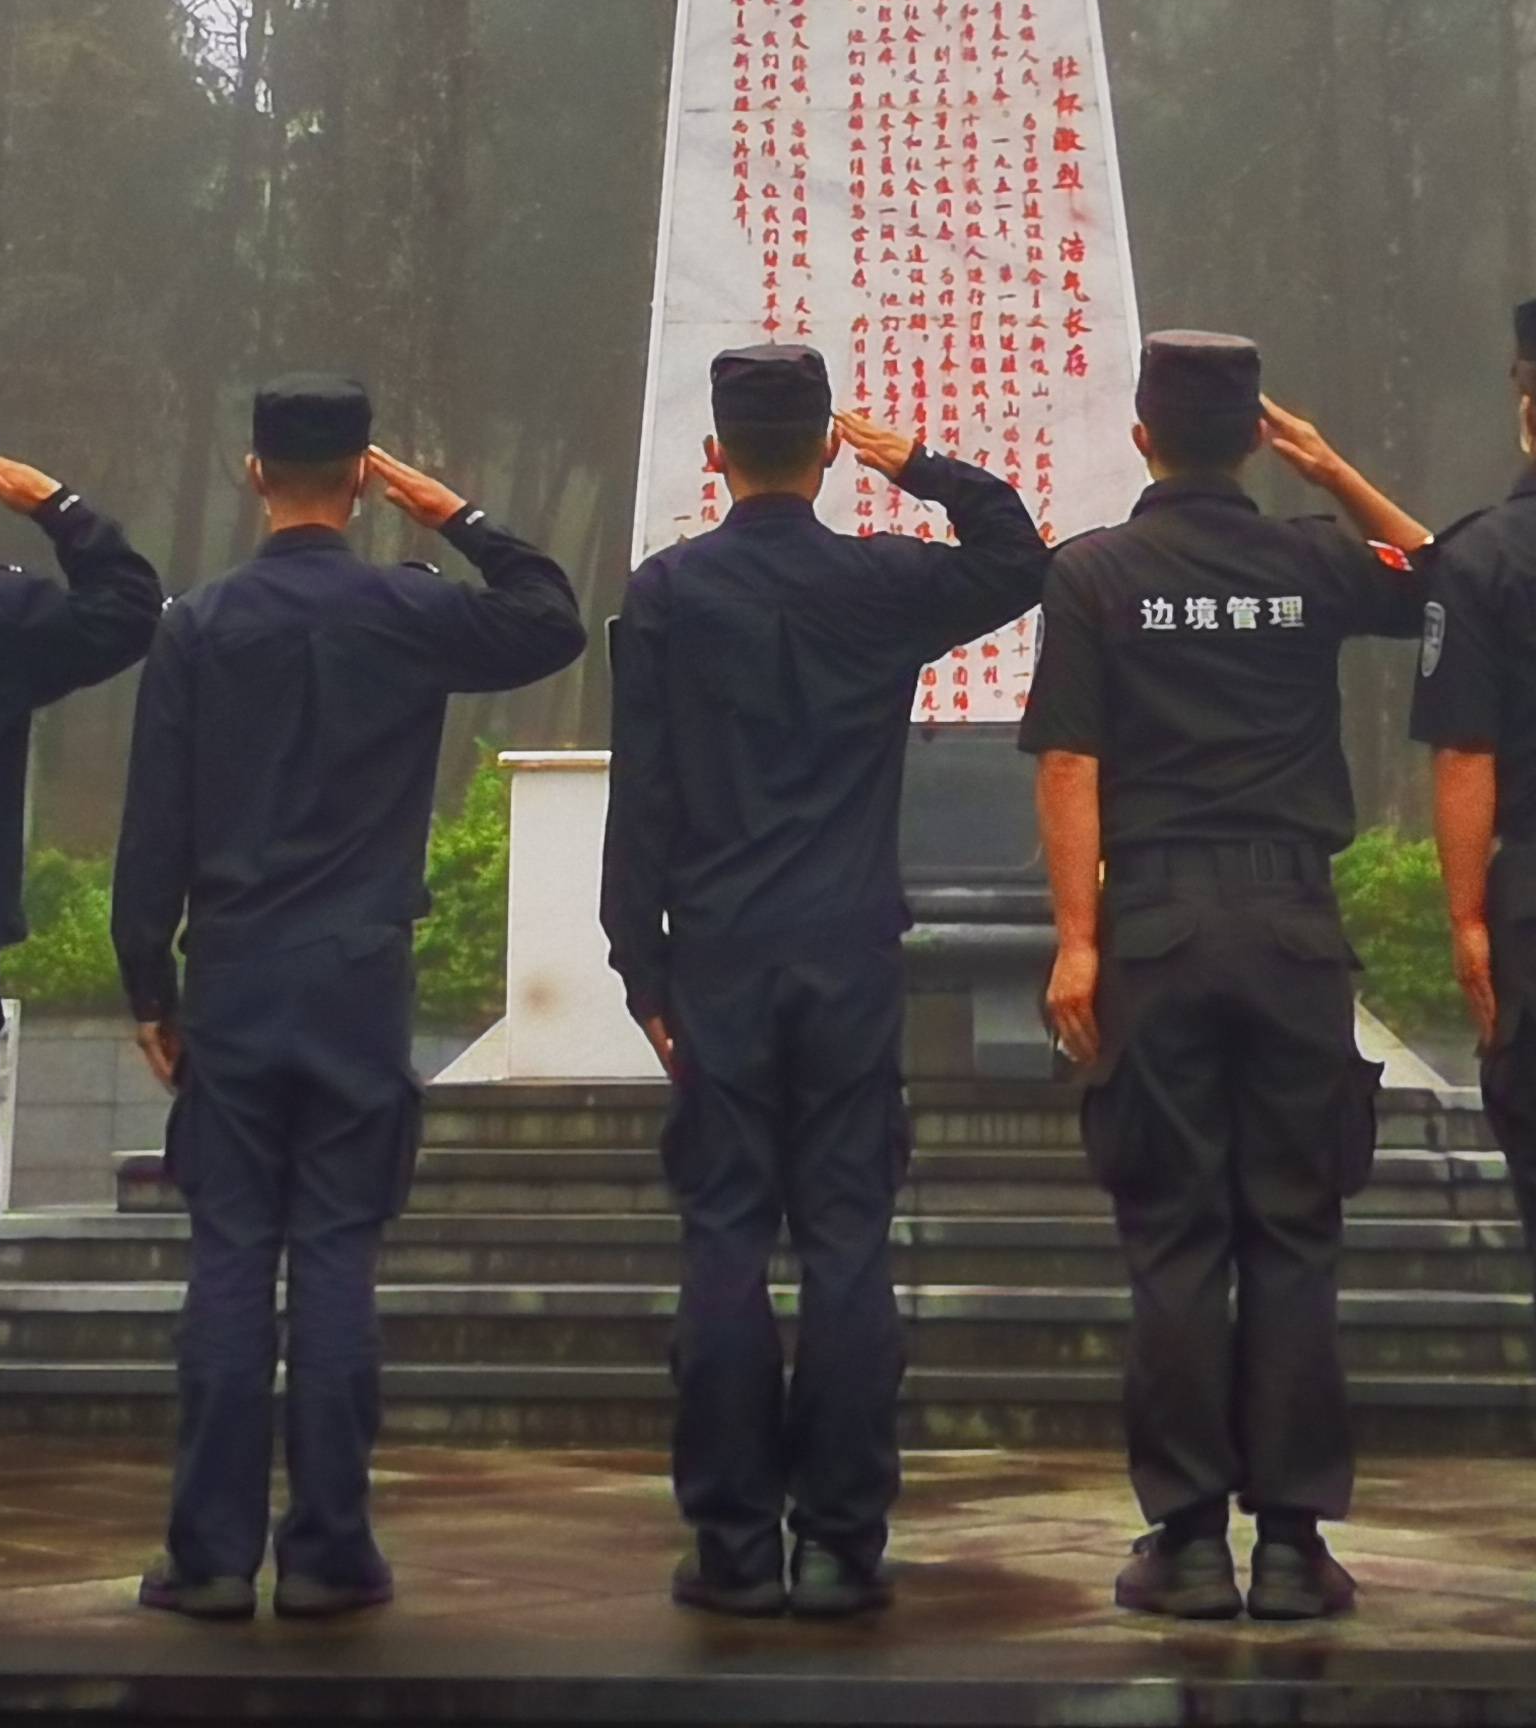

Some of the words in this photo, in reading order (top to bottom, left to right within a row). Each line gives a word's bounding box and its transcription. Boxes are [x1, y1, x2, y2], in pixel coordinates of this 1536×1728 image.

[1058, 231, 1093, 378] 浩气长存
[1140, 596, 1305, 630] 边境管理
